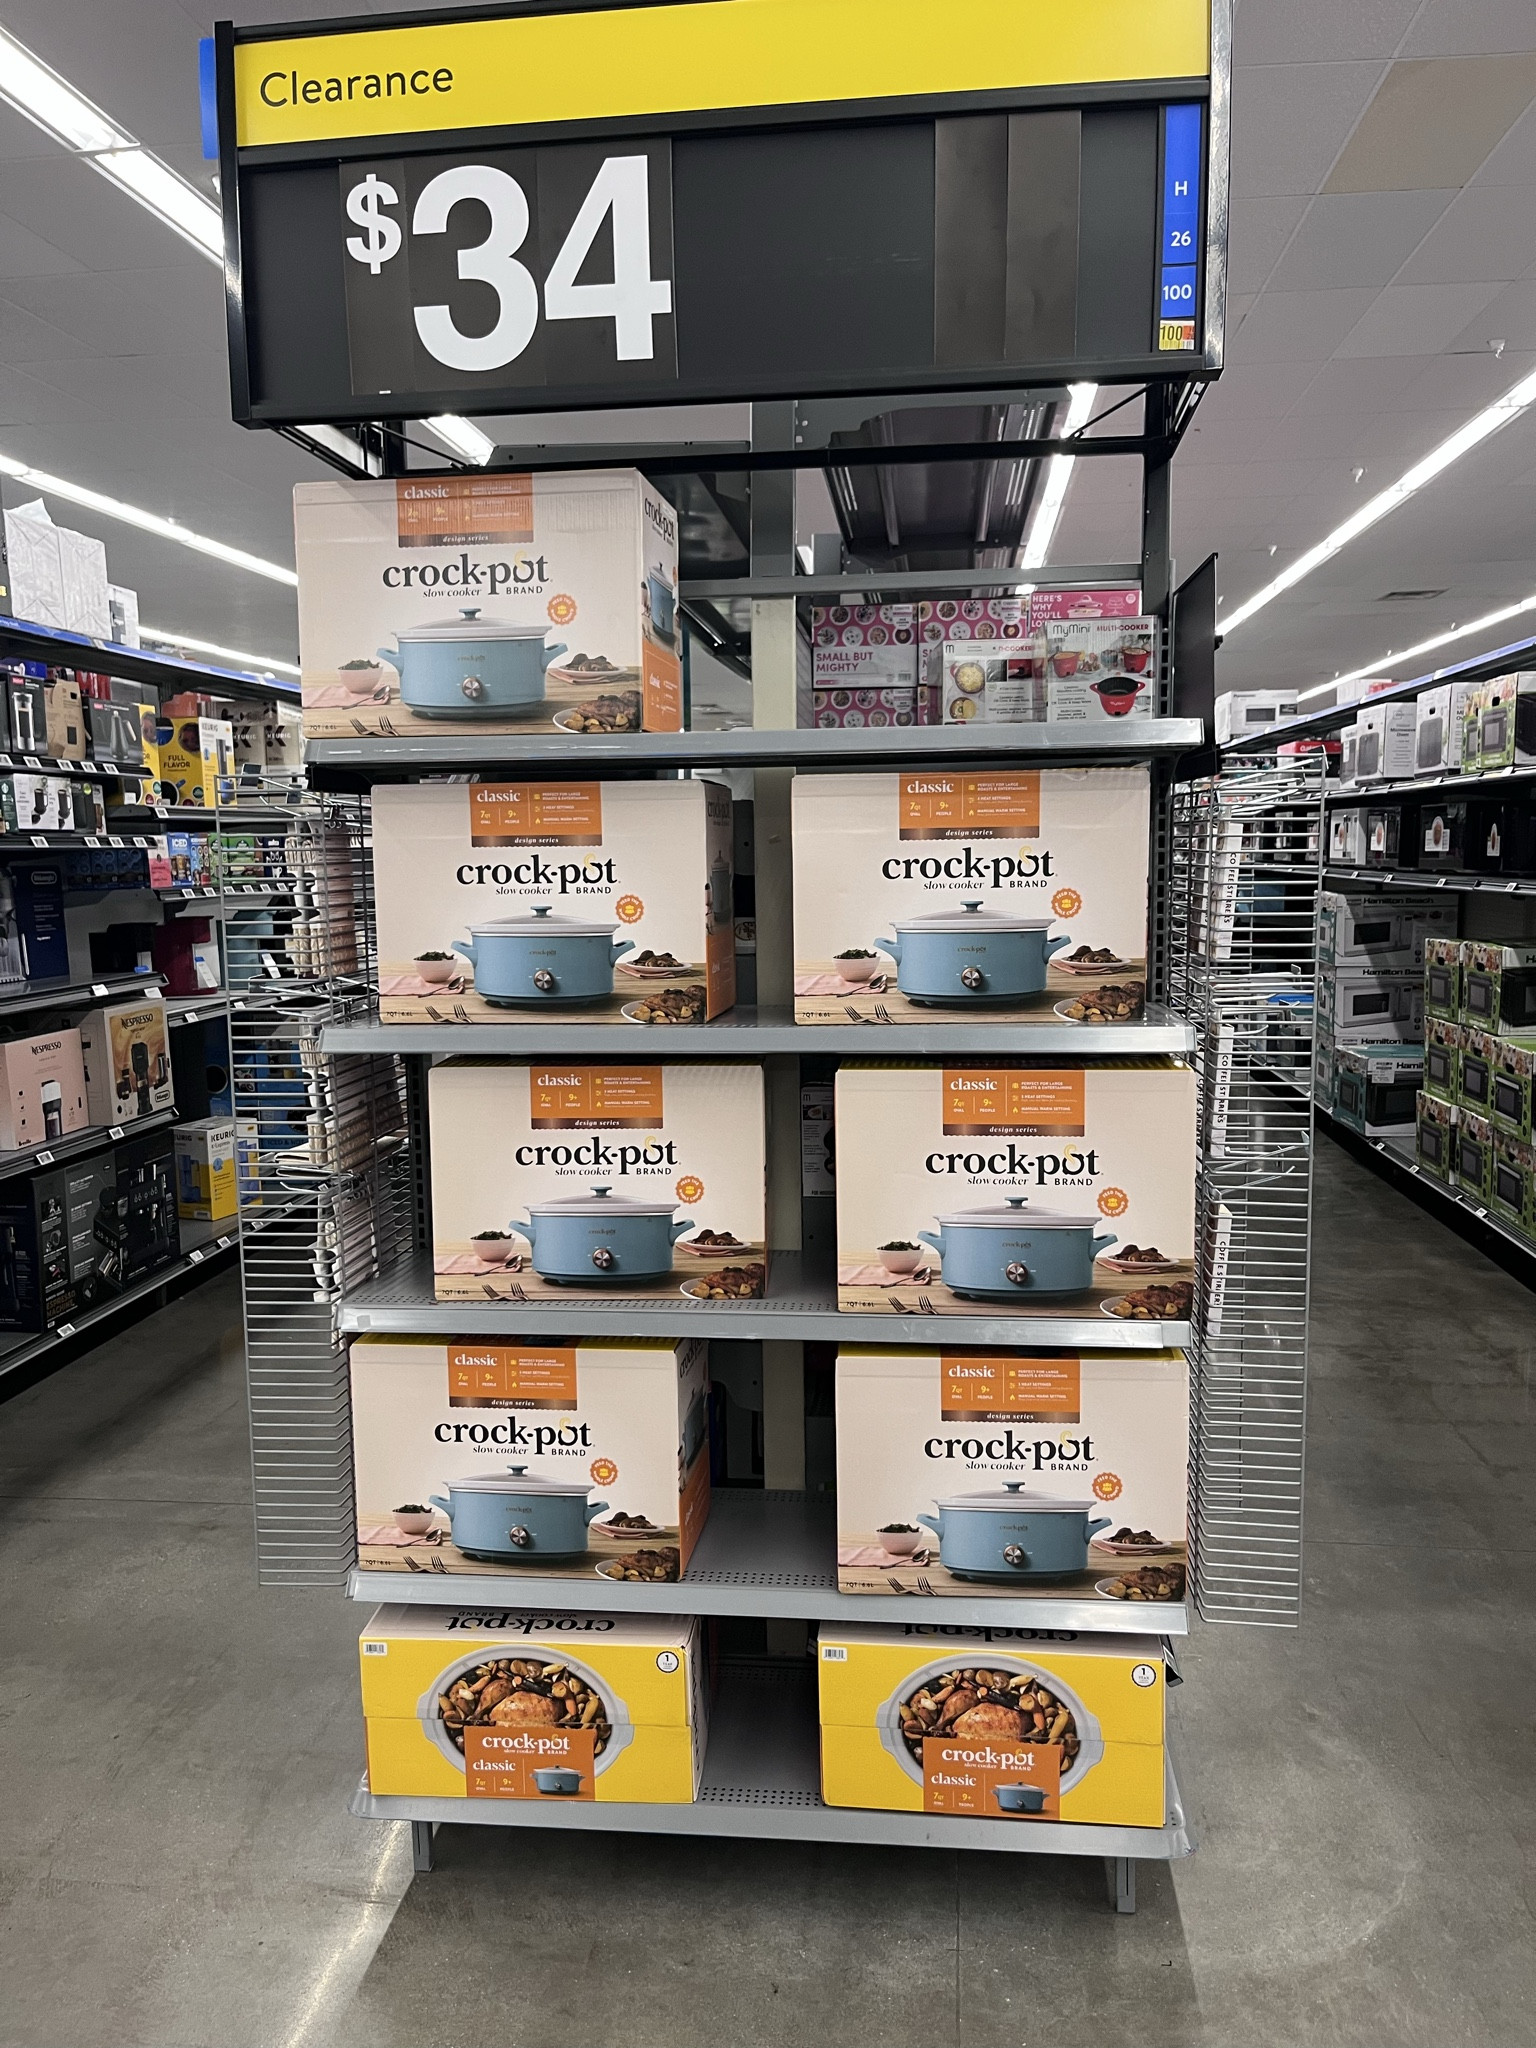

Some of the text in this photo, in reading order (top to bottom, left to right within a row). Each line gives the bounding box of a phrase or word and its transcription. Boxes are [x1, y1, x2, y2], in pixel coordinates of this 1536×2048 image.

[260, 66, 454, 108] Clearance
[1174, 180, 1188, 197] H
[1170, 230, 1192, 247] 26
[345, 153, 672, 372] $34
[1162, 283, 1192, 301] 100
[404, 484, 450, 500] classic
[423, 586, 482, 598] slow cooker
[506, 585, 543, 595] BRAND
[816, 652, 874, 662] SMALL BUT
[816, 663, 859, 672] MIGHTY
[907, 780, 954, 794] classic
[477, 789, 521, 802] classic
[538, 836, 559, 844] series
[923, 879, 984, 890] slow cooker
[1010, 880, 1048, 888] BRAND
[495, 885, 552, 896] slow cooker
[576, 886, 612, 894] BRAND
[122, 1014, 154, 1030] NESPRESSO
[31, 1041, 62, 1056] NESPRESSO
[538, 1074, 582, 1086] classic
[950, 1077, 998, 1090] classic
[575, 1119, 598, 1127] design
[989, 1126, 1014, 1134] design
[555, 1166, 612, 1176] slow cooker
[636, 1167, 672, 1176] BRAND
[967, 1176, 1030, 1186] slow cooker
[1054, 1178, 1094, 1186] BRAND
[454, 1353, 498, 1366] classic
[948, 1365, 995, 1378] classic
[986, 1412, 1011, 1420] design
[473, 1444, 528, 1456] slow cooker
[551, 1448, 586, 1456] BRAND
[965, 1460, 1026, 1472] slow cooker
[1050, 1463, 1088, 1472] BRAND
[664, 1654, 670, 1662] 1
[1141, 1667, 1146, 1676] 1
[472, 1759, 516, 1772] classic
[931, 1774, 977, 1786] classic
